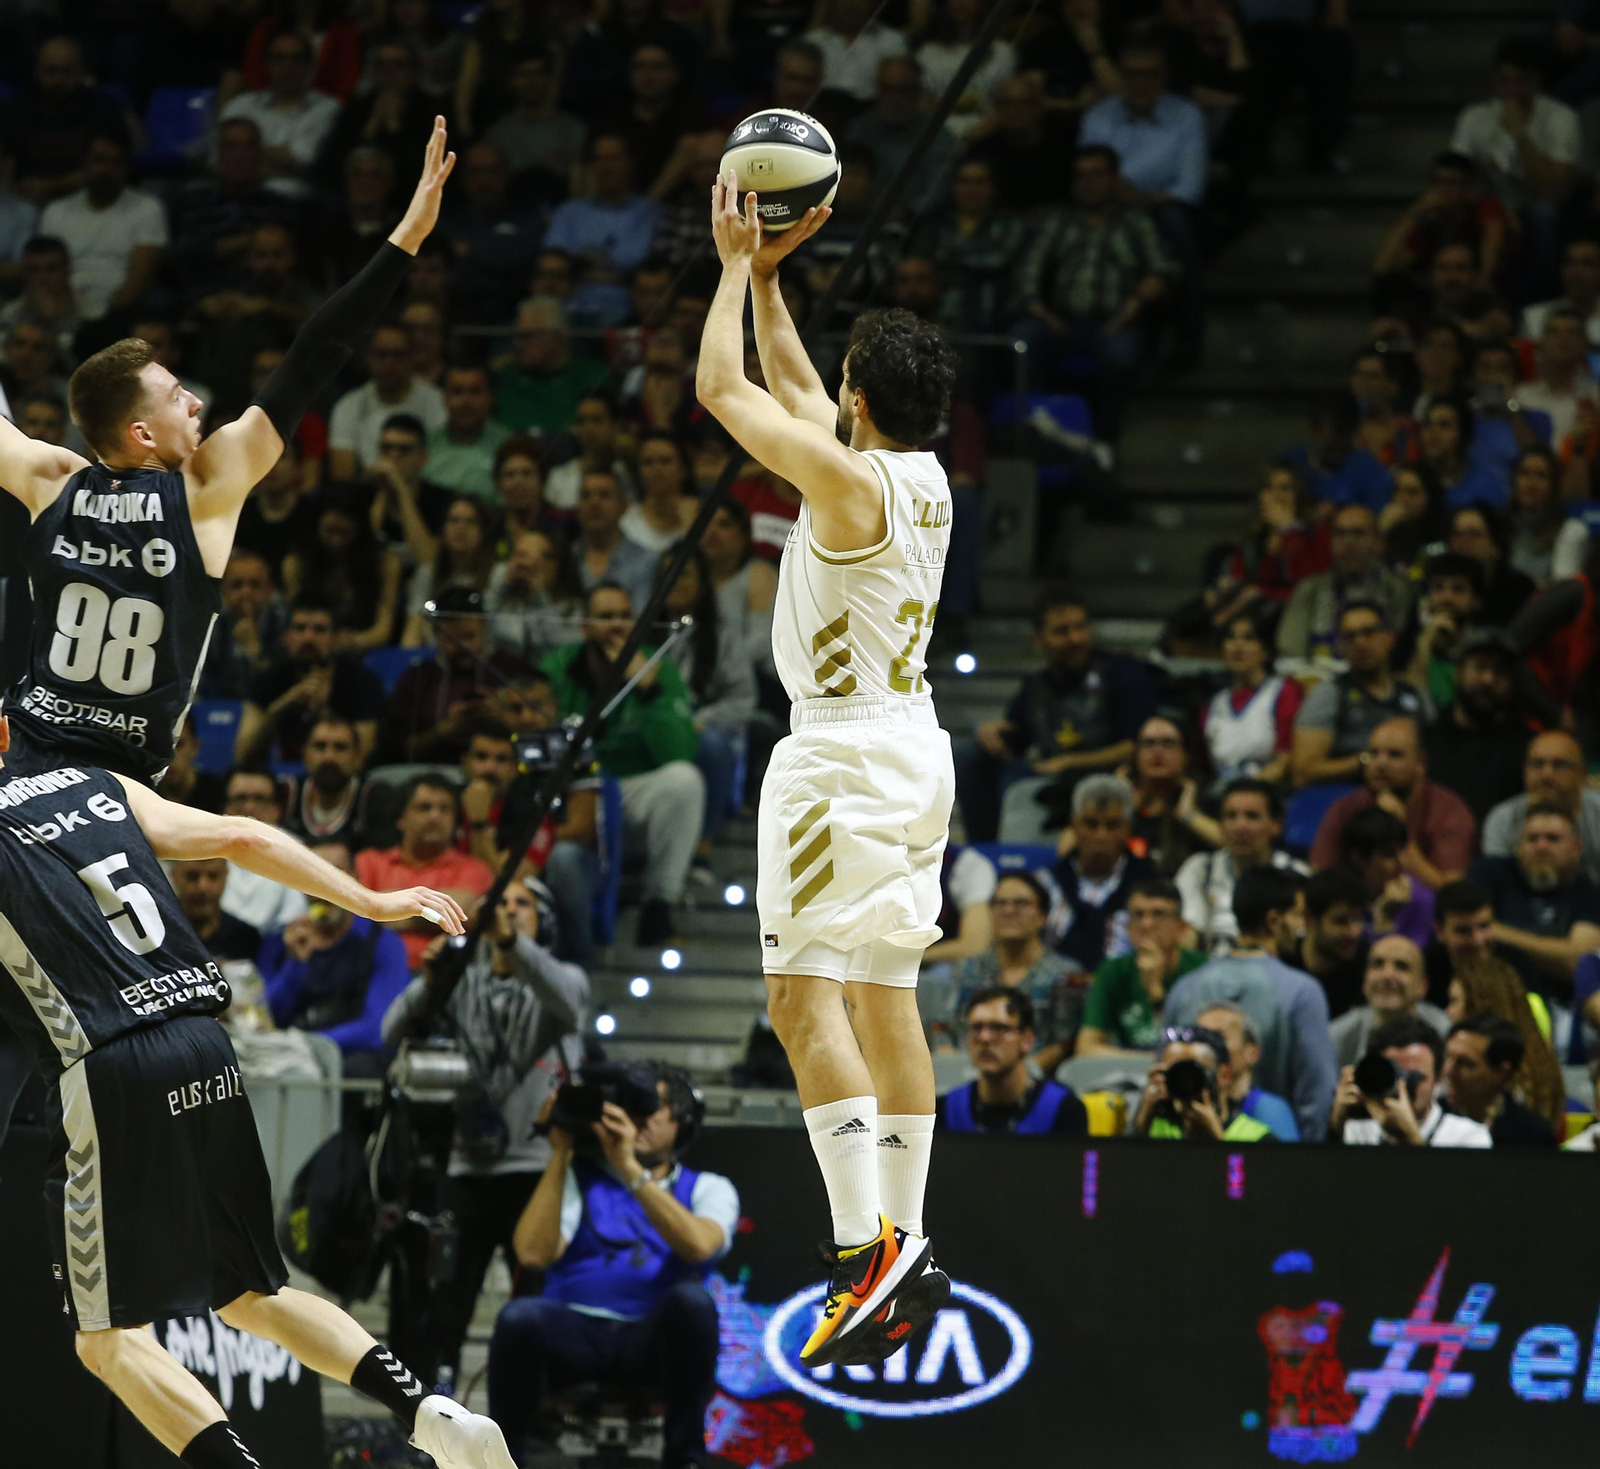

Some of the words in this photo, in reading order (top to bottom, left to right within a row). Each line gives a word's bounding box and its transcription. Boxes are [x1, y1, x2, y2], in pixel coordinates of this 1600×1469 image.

[52, 534, 134, 568] bbk
[49, 582, 164, 696] 98
[28, 686, 148, 733] BEOTIBAR
[77, 852, 165, 955] 5
[119, 961, 222, 1006] BEOTIBAR
[832, 1127, 870, 1137] adidas
